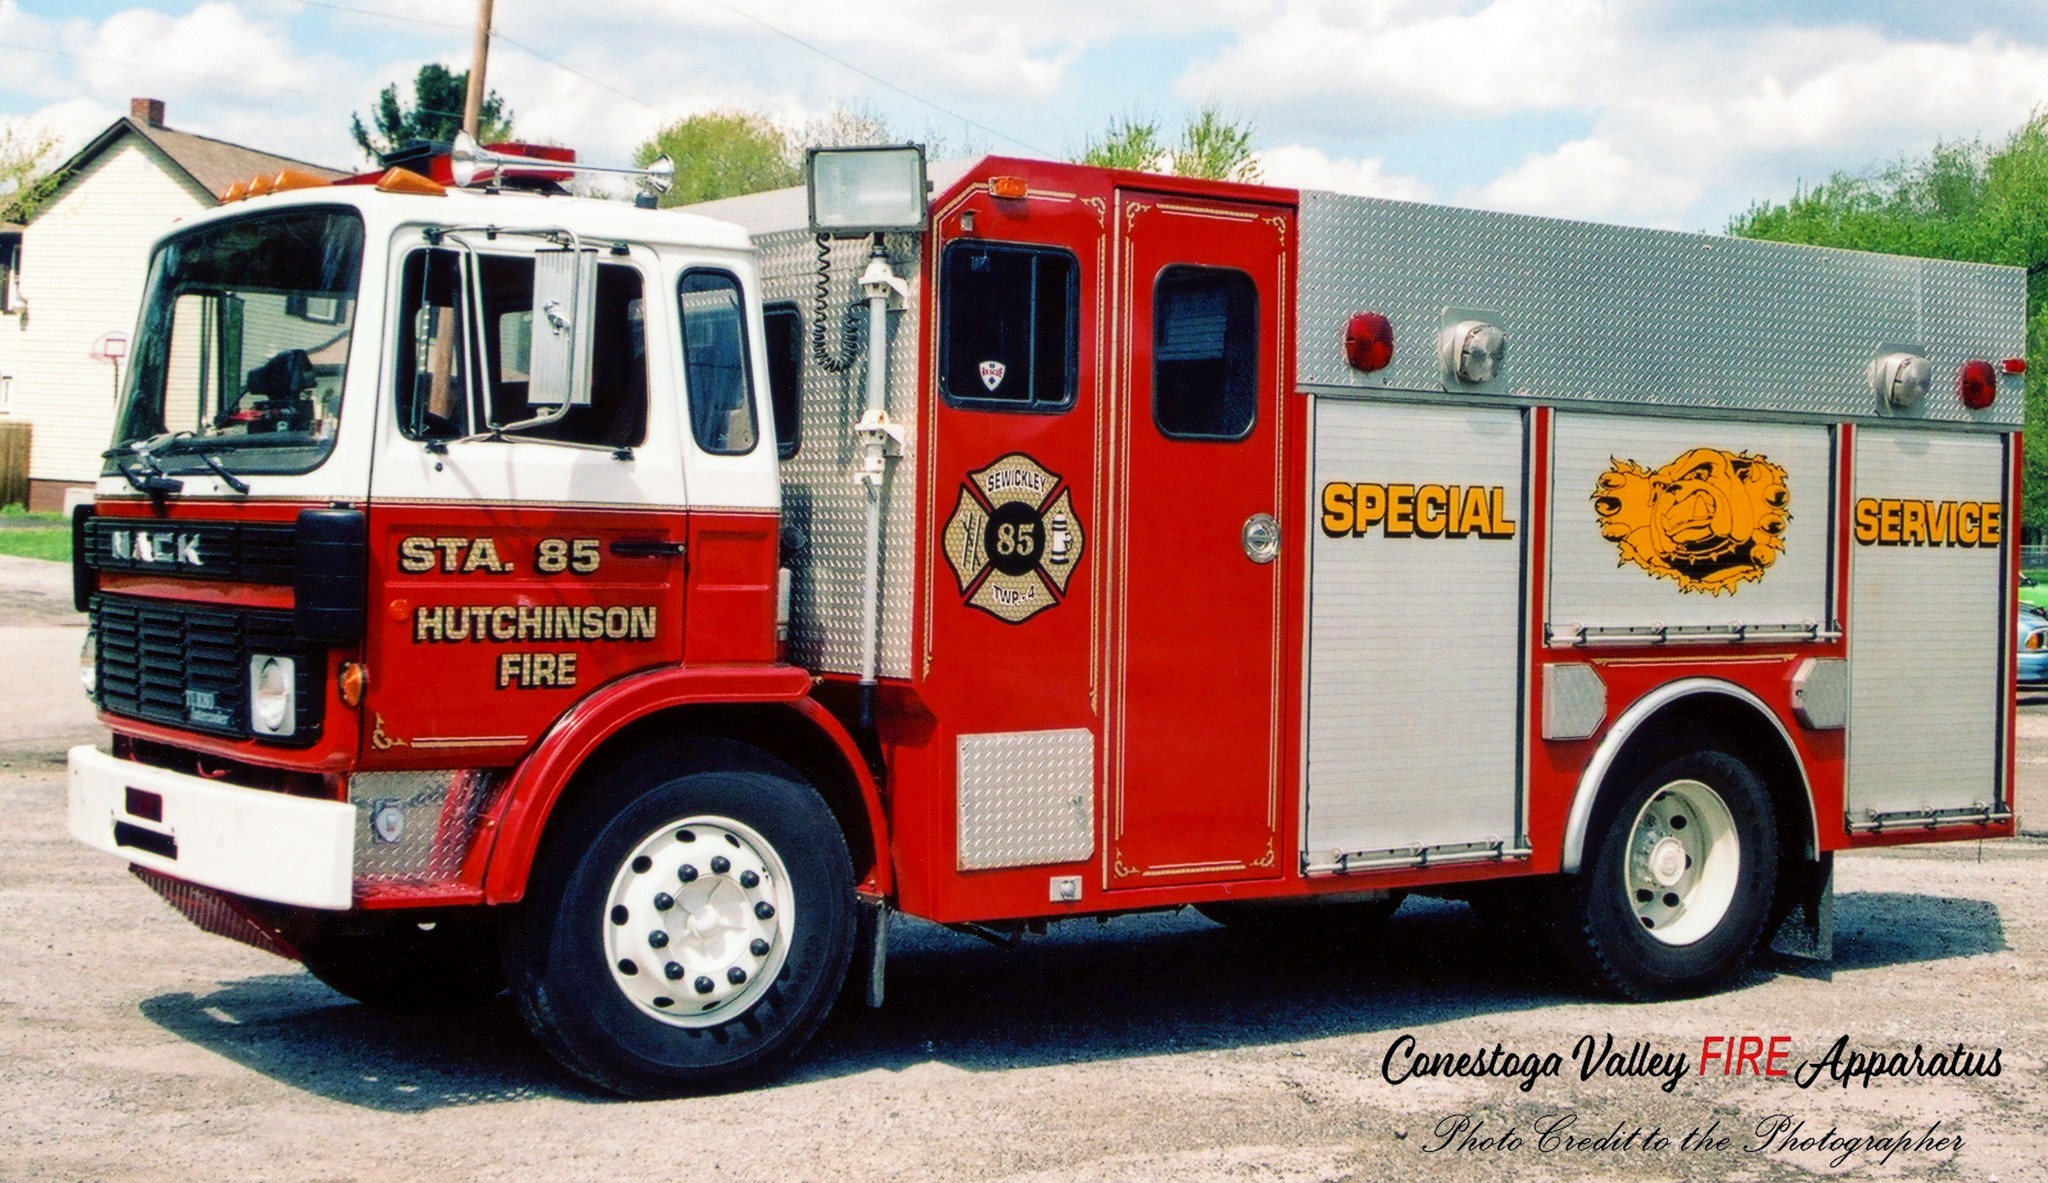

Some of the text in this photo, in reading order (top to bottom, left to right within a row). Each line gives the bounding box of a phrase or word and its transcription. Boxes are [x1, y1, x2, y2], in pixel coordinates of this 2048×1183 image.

[987, 469, 1046, 493] SEWICKLEY
[1321, 482, 1515, 539] SPECIAL
[1854, 498, 2000, 548] SERVICE
[111, 530, 204, 566] MACK
[398, 537, 601, 575] STA. 85
[997, 523, 1035, 556] 85
[413, 606, 657, 642] HUTCHINSON
[496, 653, 577, 689] FIRE
